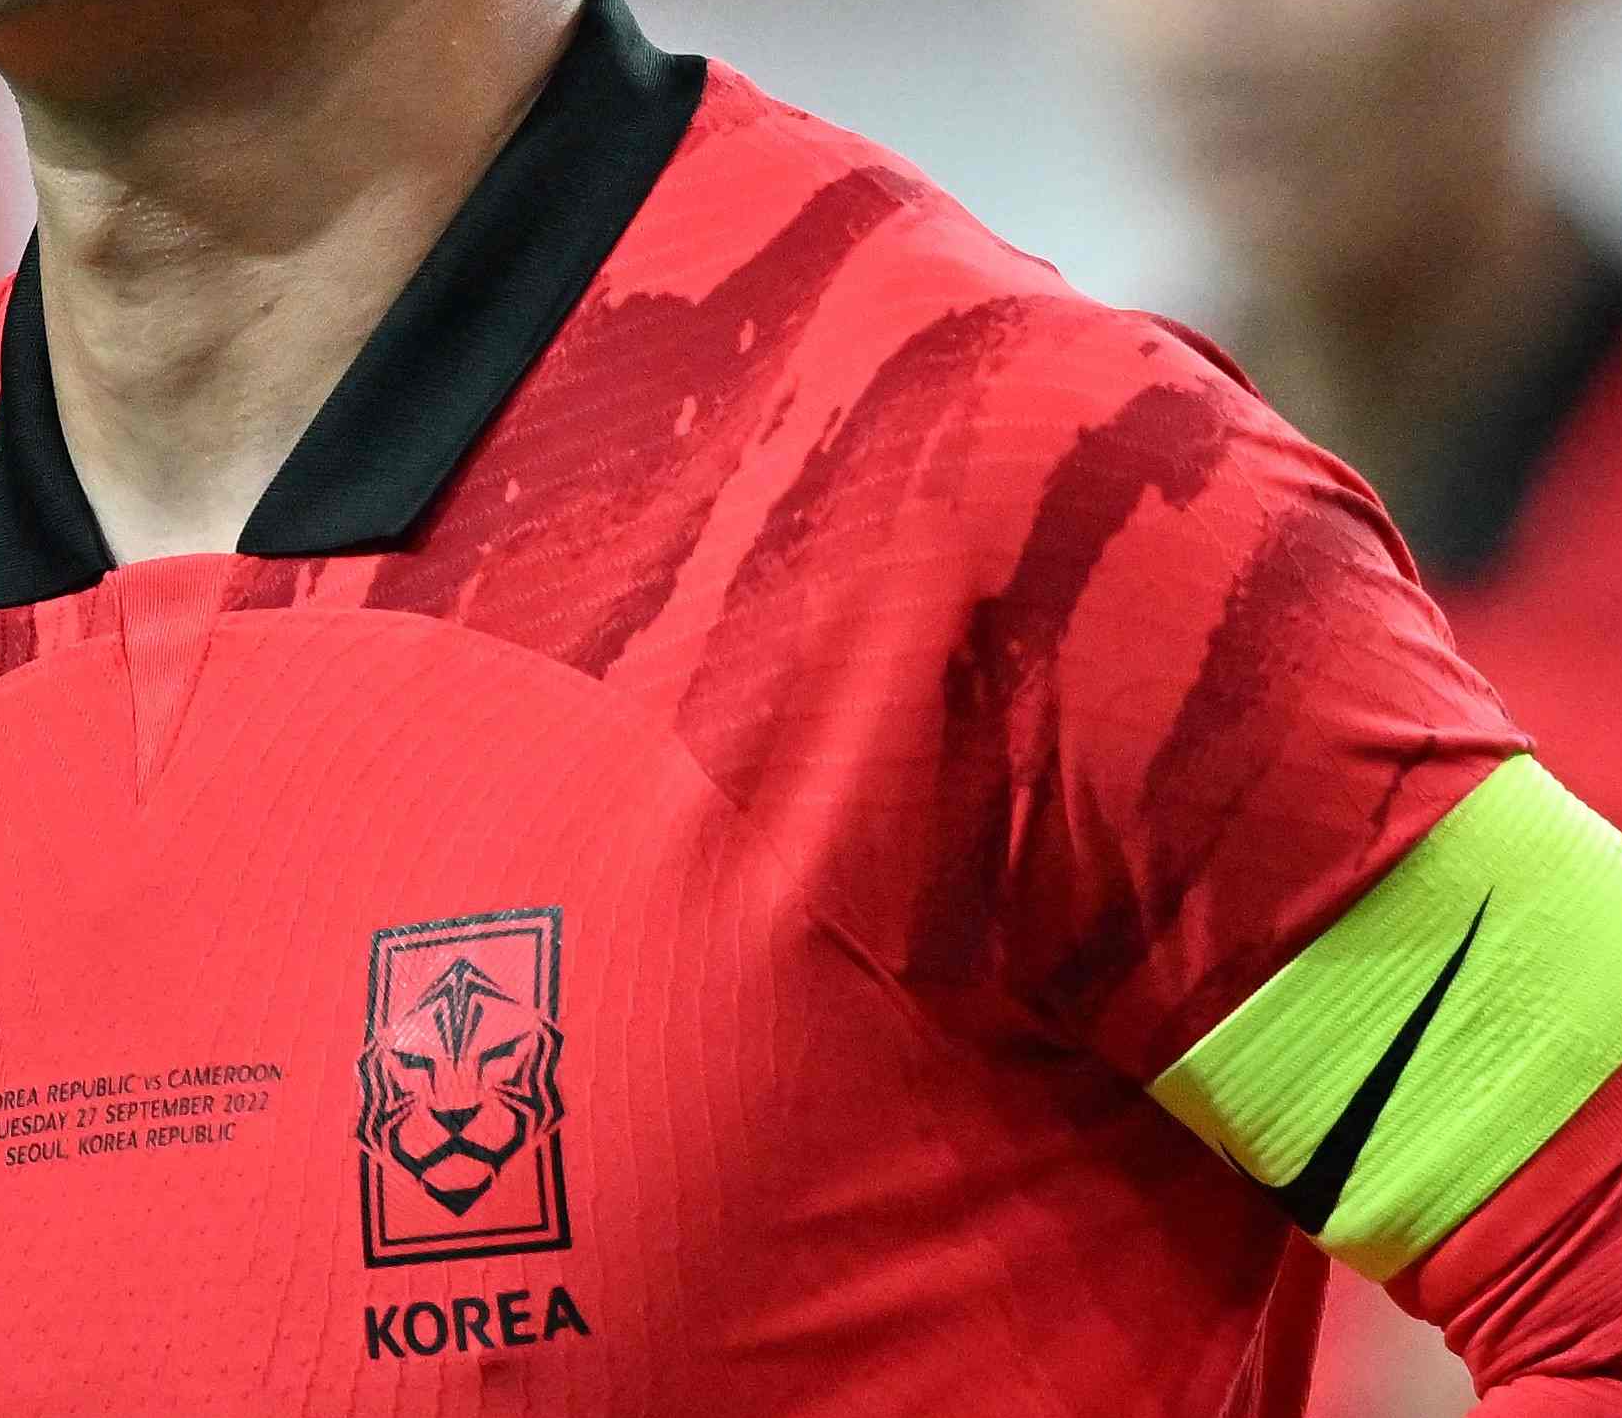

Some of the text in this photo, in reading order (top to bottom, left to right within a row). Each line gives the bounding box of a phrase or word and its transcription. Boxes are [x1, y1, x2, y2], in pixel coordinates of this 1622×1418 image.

[47, 1073, 138, 1103] REPUBLIC
[168, 1063, 283, 1088] CAMEROON
[76, 1107, 98, 1128] 27
[105, 1094, 214, 1124] SEPTEMBER
[223, 1091, 269, 1113] 2022
[78, 1131, 137, 1157] KOREA
[145, 1122, 237, 1148] REPUBLIC
[364, 1286, 591, 1360] KOREA
